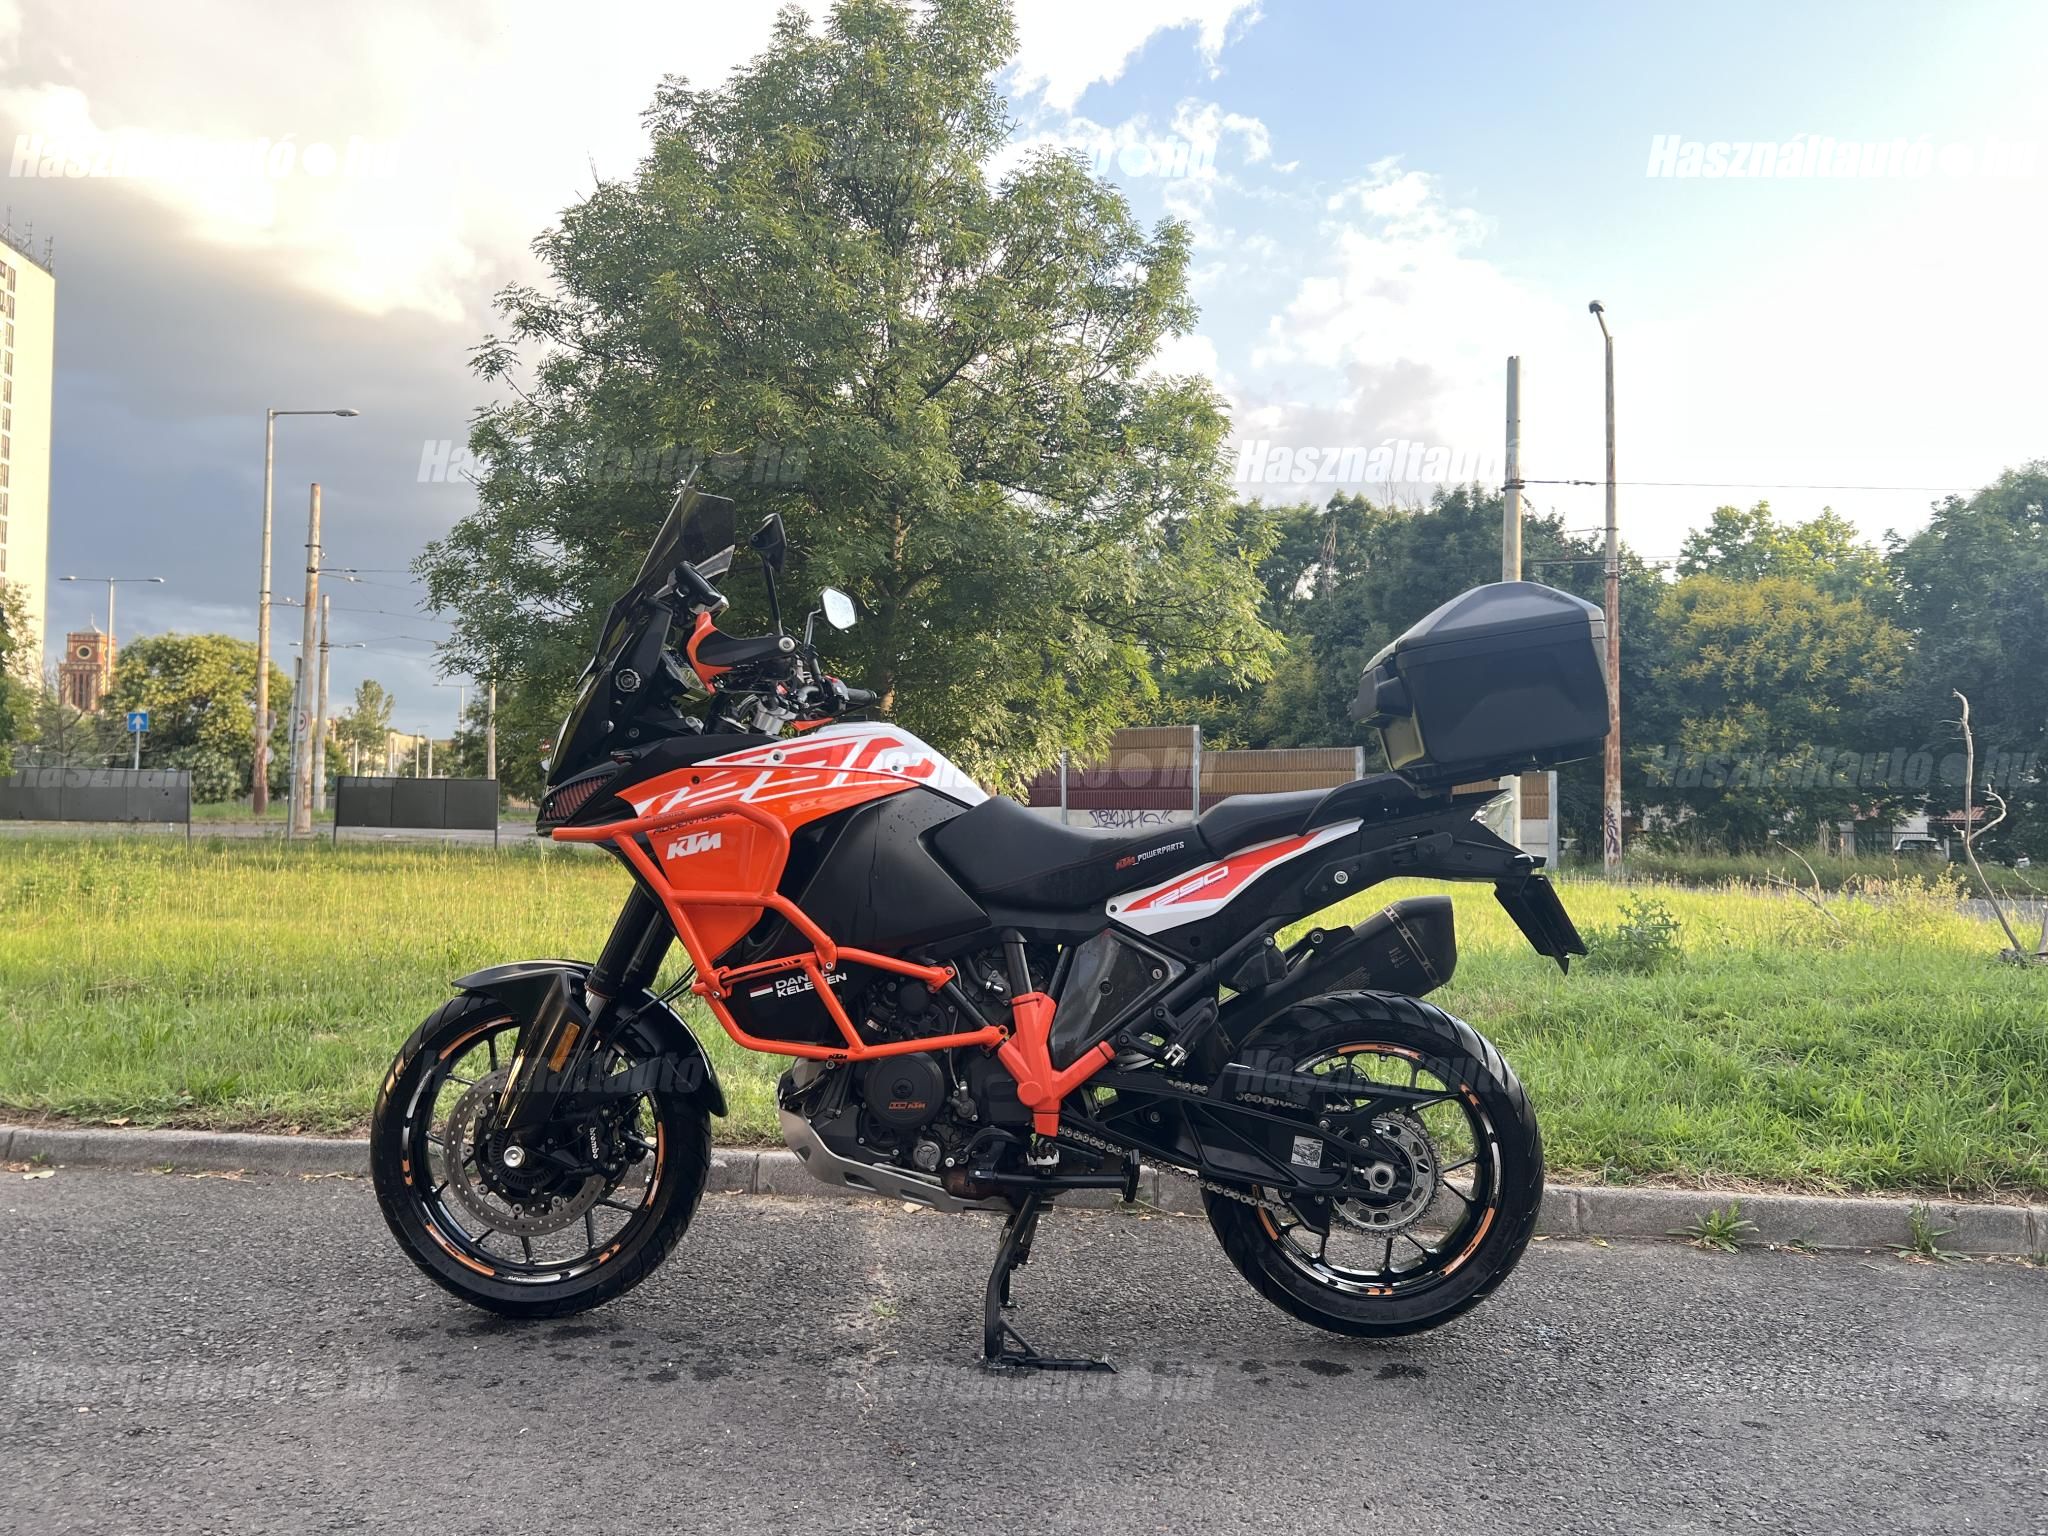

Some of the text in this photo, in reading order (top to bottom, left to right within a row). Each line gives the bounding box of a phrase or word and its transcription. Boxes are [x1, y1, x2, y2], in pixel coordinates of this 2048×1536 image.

[666, 831, 722, 860] KTM
[775, 969, 831, 990] DANL
[777, 973, 848, 998] KELEEN
[589, 1127, 599, 1159] brembo
